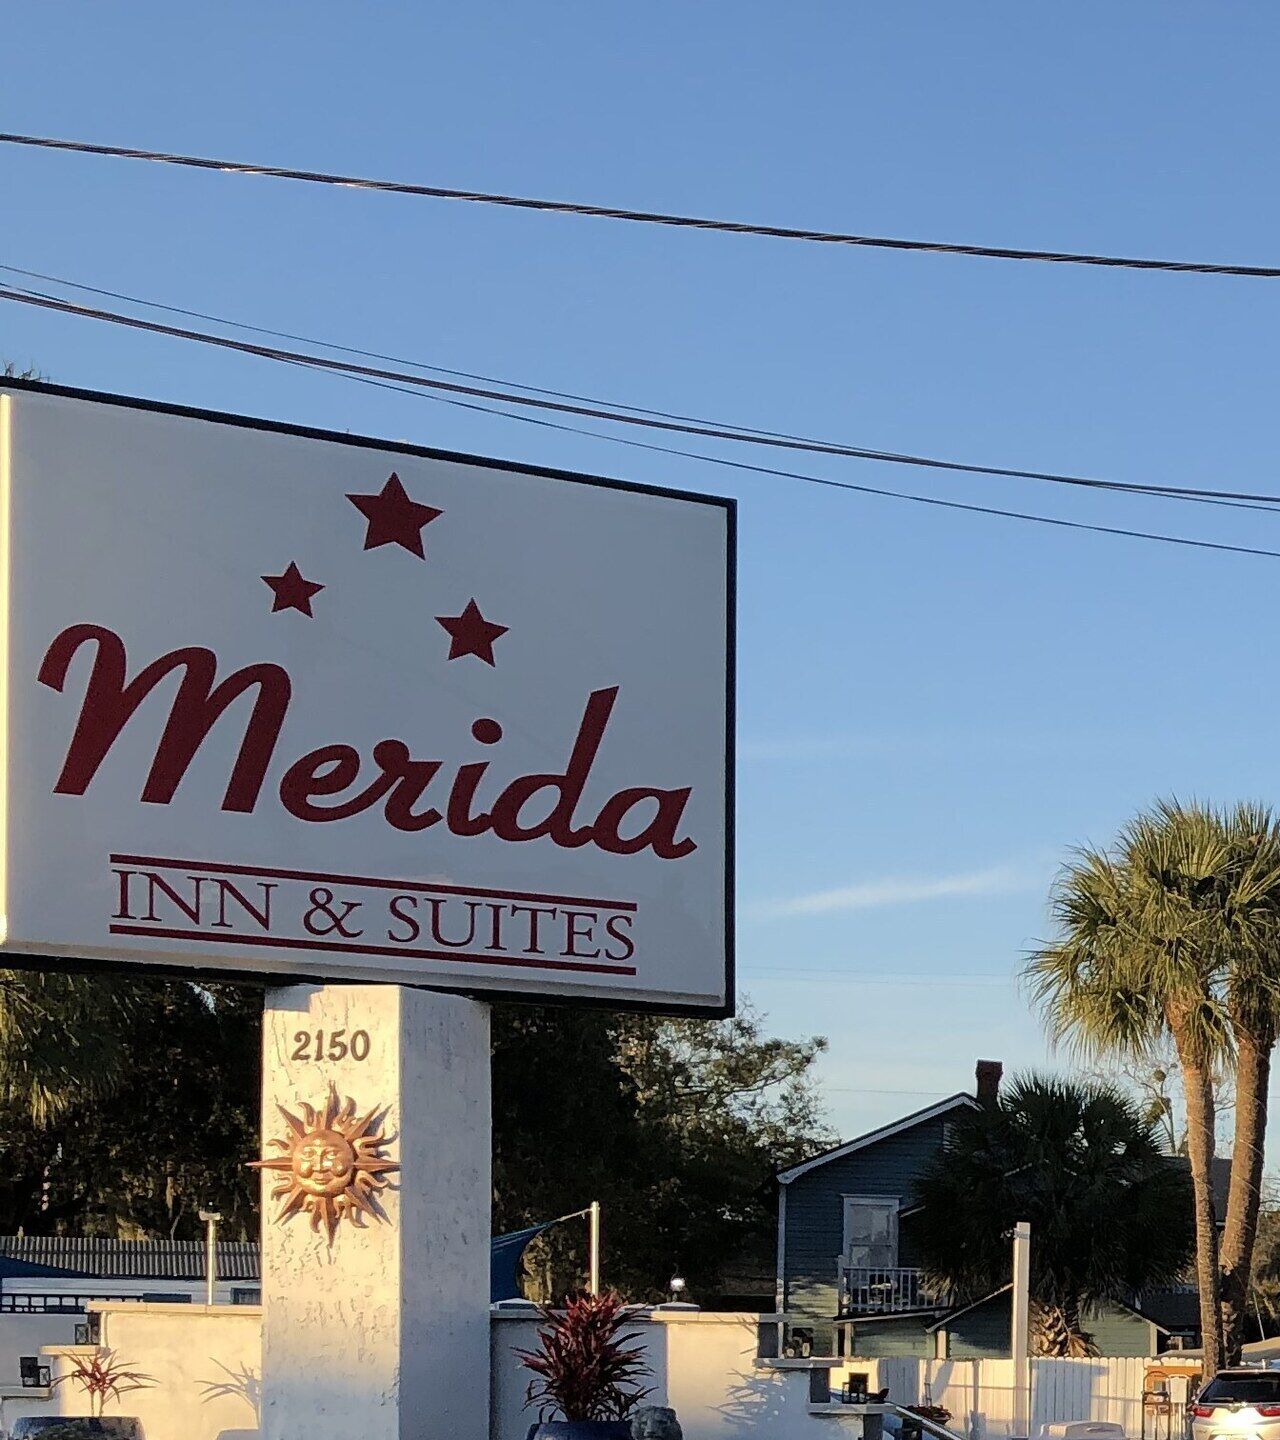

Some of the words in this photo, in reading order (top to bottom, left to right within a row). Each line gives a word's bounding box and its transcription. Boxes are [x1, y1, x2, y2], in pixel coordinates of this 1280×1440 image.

[37, 623, 697, 860] Merida
[111, 870, 279, 931] INN
[302, 887, 364, 940] &
[387, 895, 637, 961] SUITES
[291, 1028, 371, 1062] 2150
